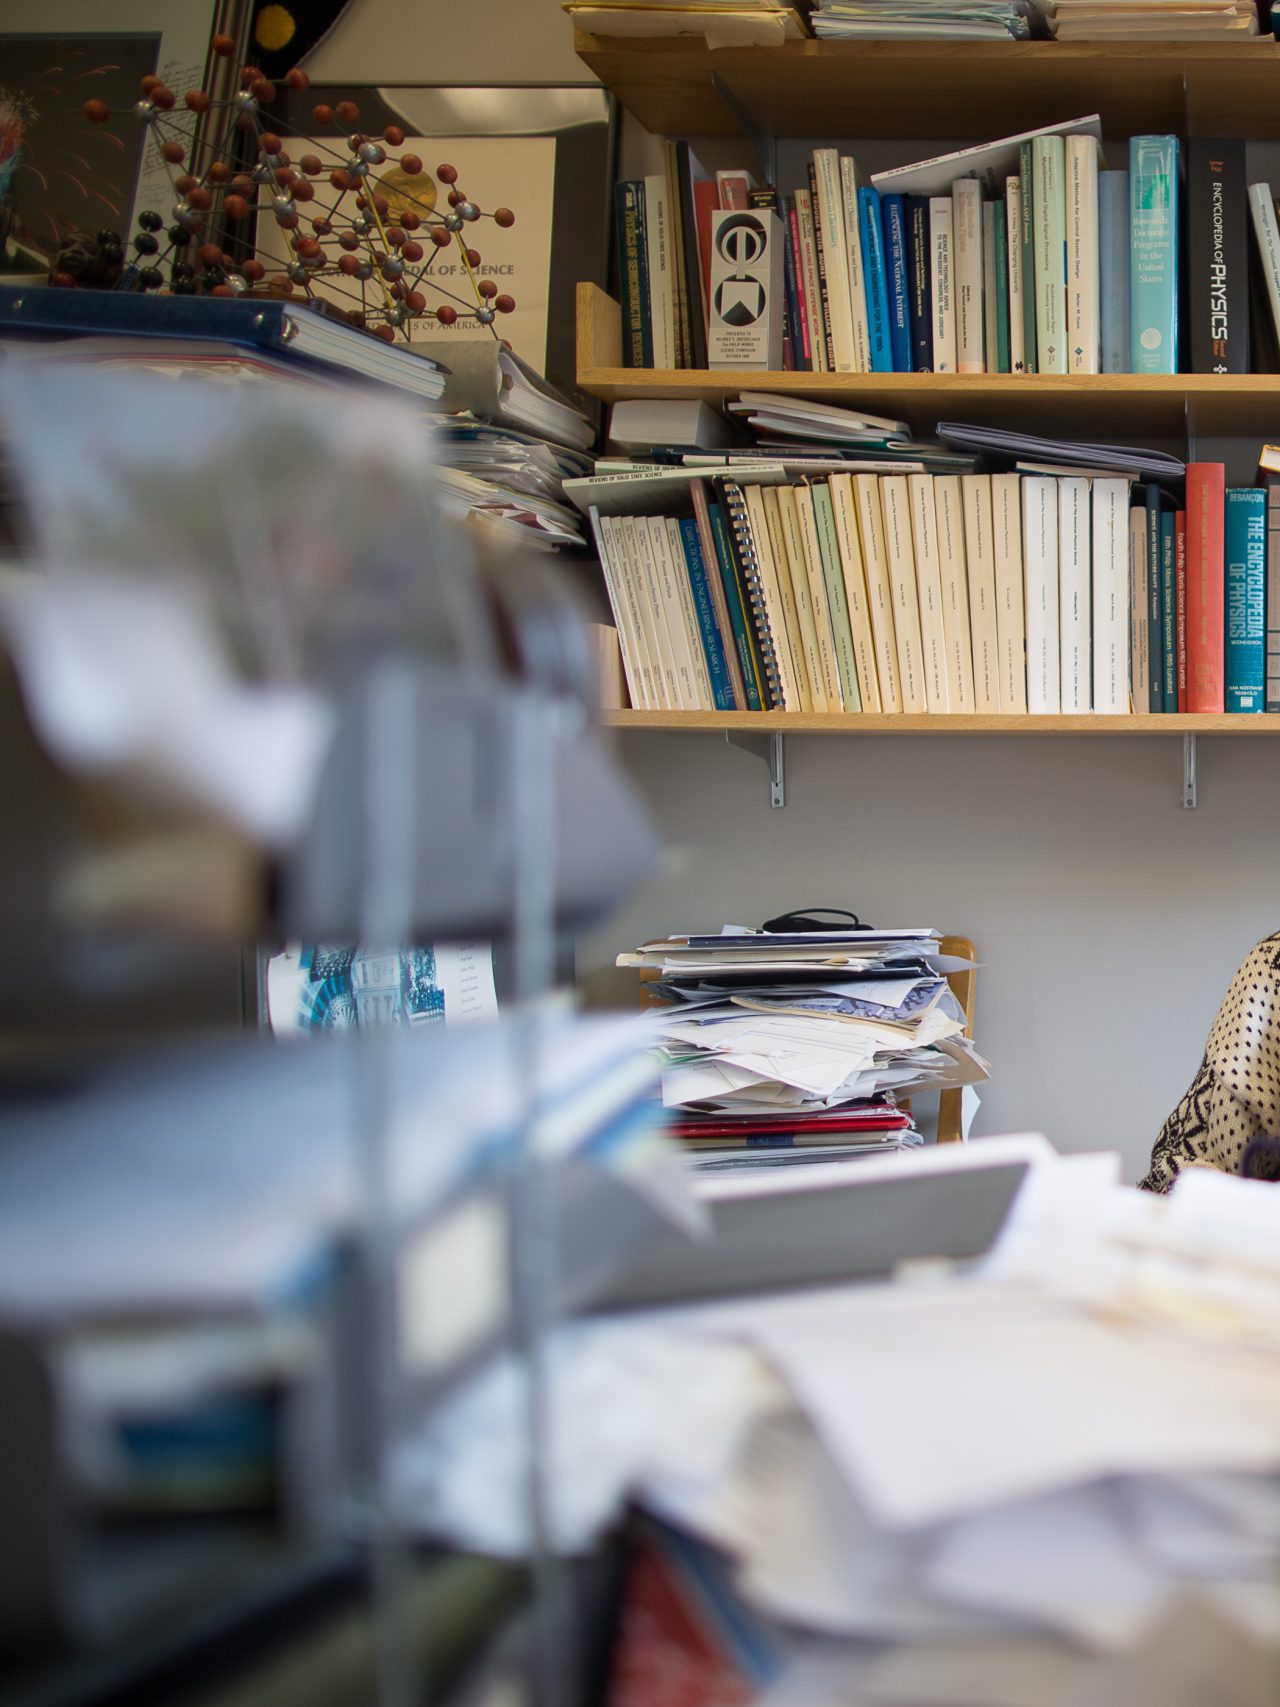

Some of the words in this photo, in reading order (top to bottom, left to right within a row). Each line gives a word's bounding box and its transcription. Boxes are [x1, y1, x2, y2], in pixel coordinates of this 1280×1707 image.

[1213, 182, 1223, 249] ENCYCLOPEDIA
[626, 211, 636, 247] PHYSICS
[627, 248, 637, 257] OF
[1214, 250, 1223, 264] OF
[438, 265, 456, 275] OF
[460, 264, 514, 275] SIENCE
[628, 259, 641, 329] SEMICONDUCTOR
[1210, 264, 1228, 340] PHYSICS
[422, 321, 437, 330] OF
[632, 332, 643, 366] DEVICES
[588, 476, 607, 484] REVIEWS
[1229, 493, 1264, 504] BESANÇON
[1248, 515, 1264, 540] THE
[685, 525, 699, 570] DIRECTIONS
[1164, 536, 1172, 550] Fifth
[1177, 532, 1185, 551] Fourth
[1164, 550, 1172, 566] Philip
[1176, 552, 1186, 569] Philip
[694, 572, 701, 581] IN
[1178, 570, 1186, 590] Morris
[1229, 563, 1246, 580] OF
[1165, 588, 1173, 613] Science
[1178, 590, 1186, 614] Science
[1248, 542, 1264, 638] ENCYCLOPEDIA
[696, 583, 712, 634] ENGINEERING
[1229, 582, 1246, 638] PHYSICS
[1164, 615, 1173, 650] Symposium
[1177, 614, 1186, 650] Symposium
[707, 635, 721, 674] RESEARCH
